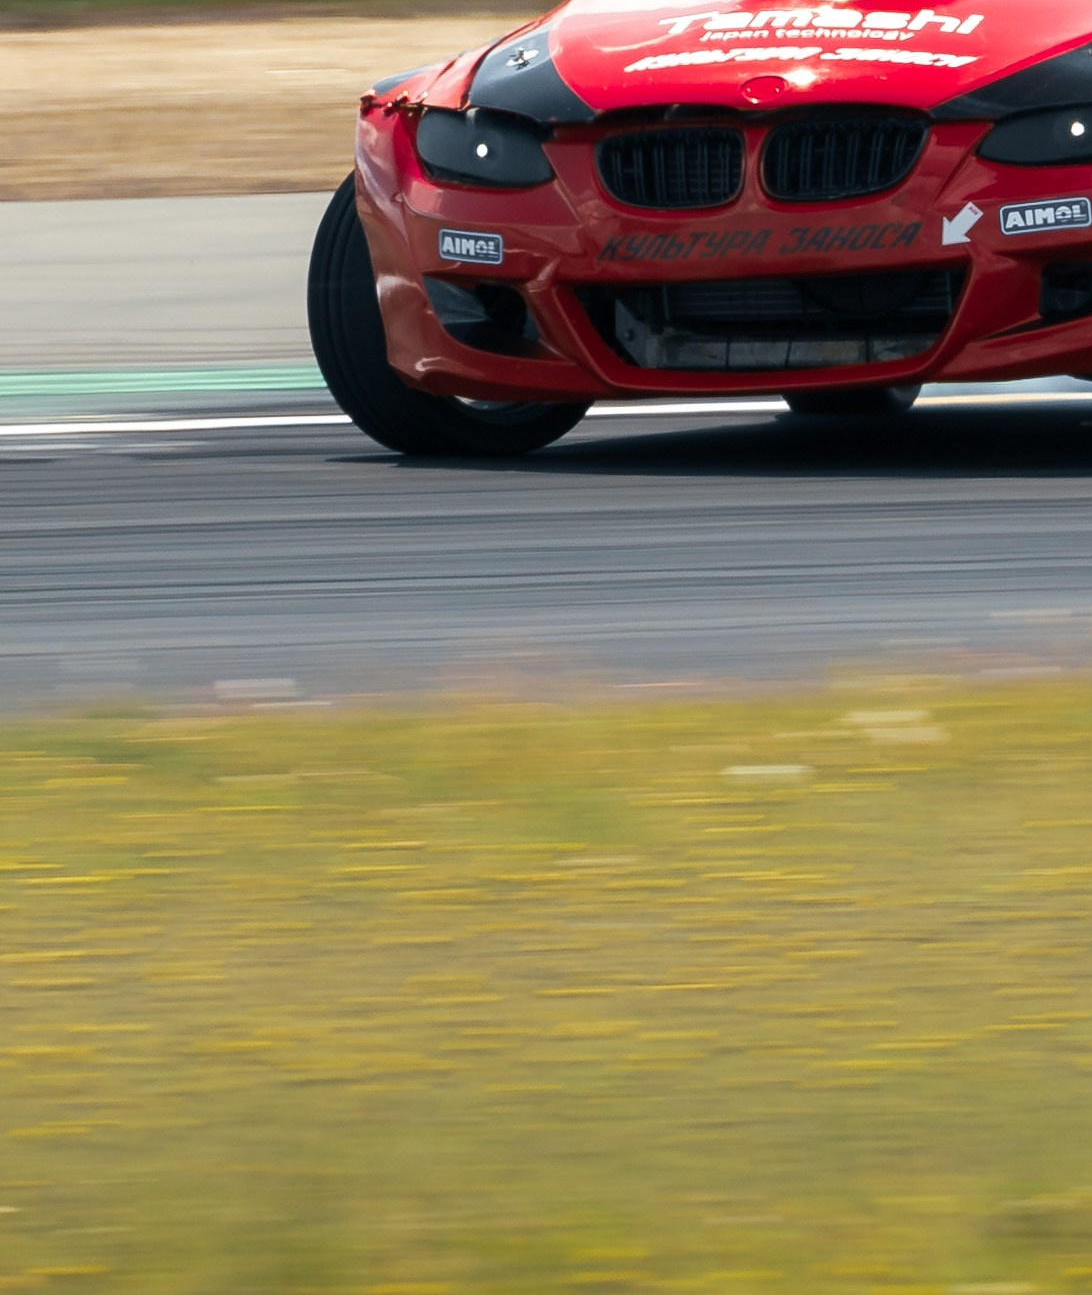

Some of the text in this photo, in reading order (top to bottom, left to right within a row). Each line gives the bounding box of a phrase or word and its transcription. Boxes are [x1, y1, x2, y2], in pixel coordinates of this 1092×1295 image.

[658, 8, 984, 35] Tamashi
[775, 27, 914, 41] technology
[1005, 205, 1086, 229] AIMOL
[443, 236, 499, 258] AIMOL
[600, 221, 924, 262] КУЛЬТУРА ЗАНОСА
